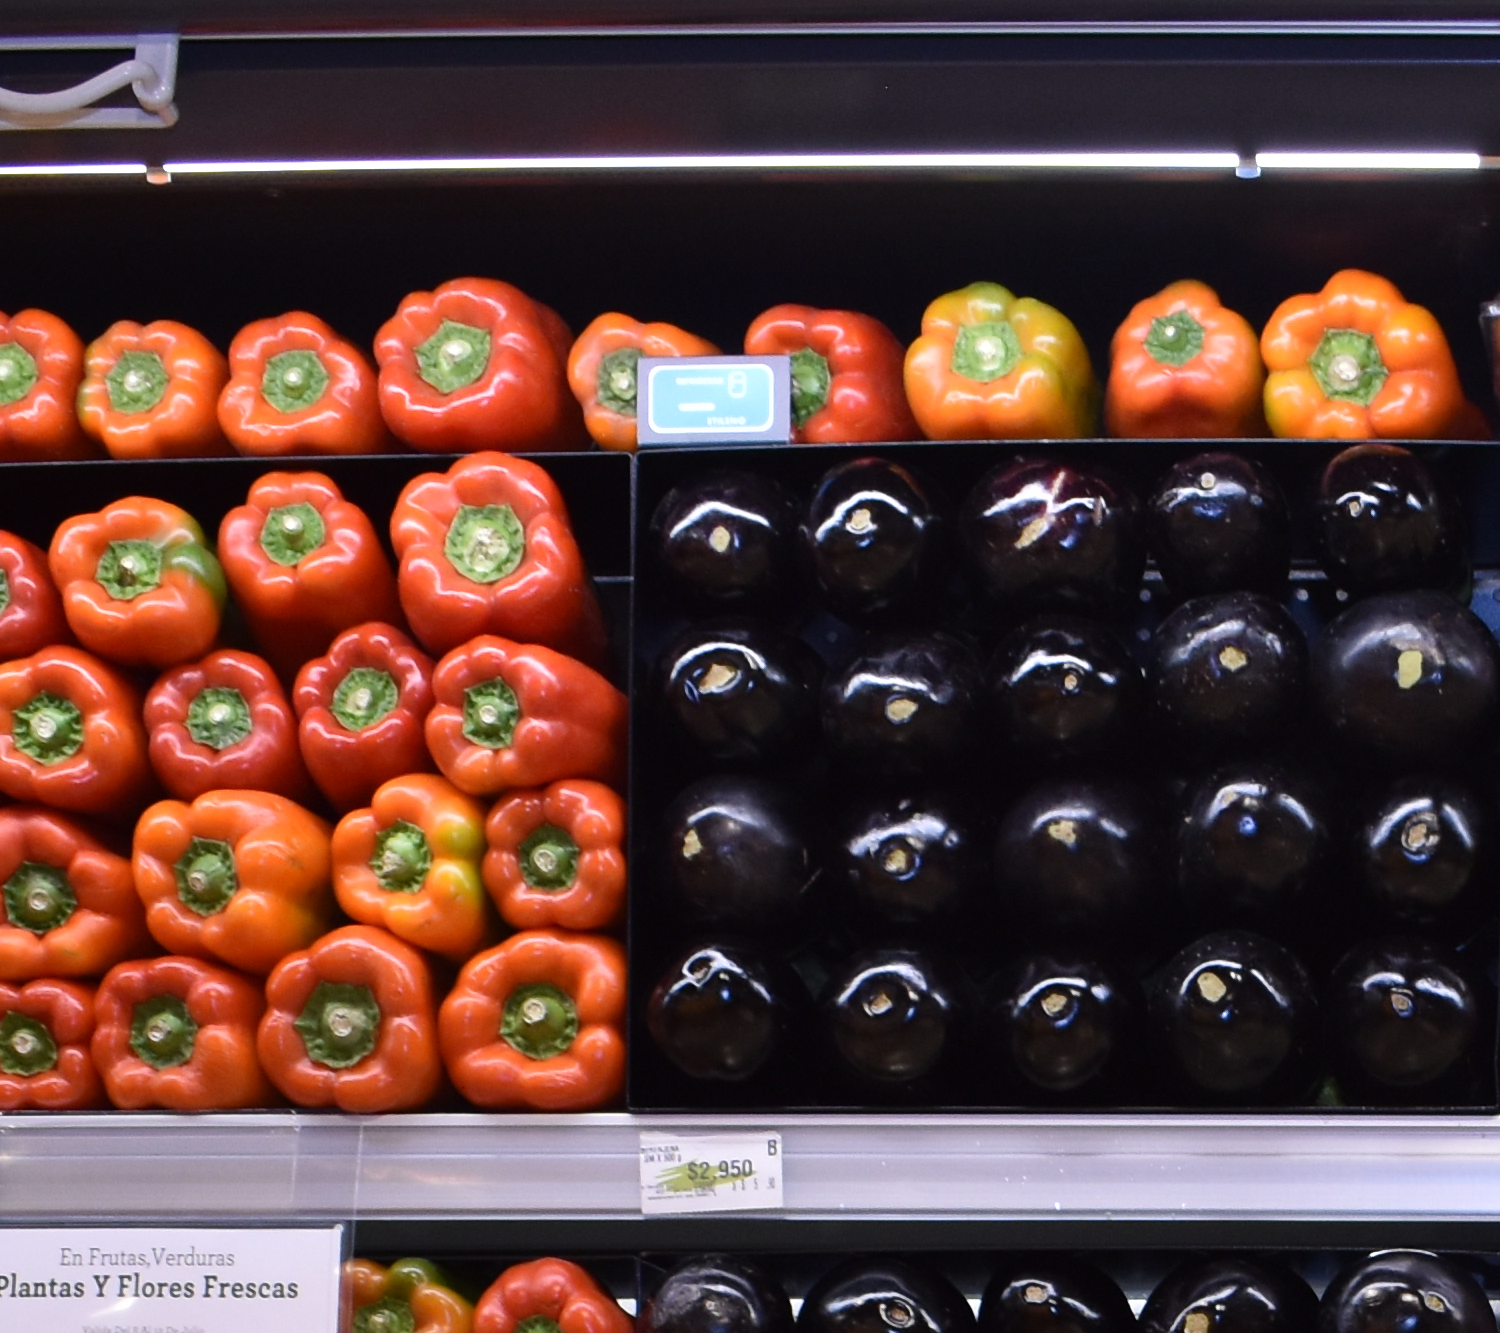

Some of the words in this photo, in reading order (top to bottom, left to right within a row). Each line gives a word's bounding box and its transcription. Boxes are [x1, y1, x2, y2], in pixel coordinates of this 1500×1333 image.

[768, 1139, 777, 1156] B
[687, 1159, 753, 1181] $2,950
[60, 1248, 83, 1266] En
[95, 1276, 109, 1298] Y
[118, 1275, 194, 1299] Flores
[203, 1277, 298, 1300] Frescas
